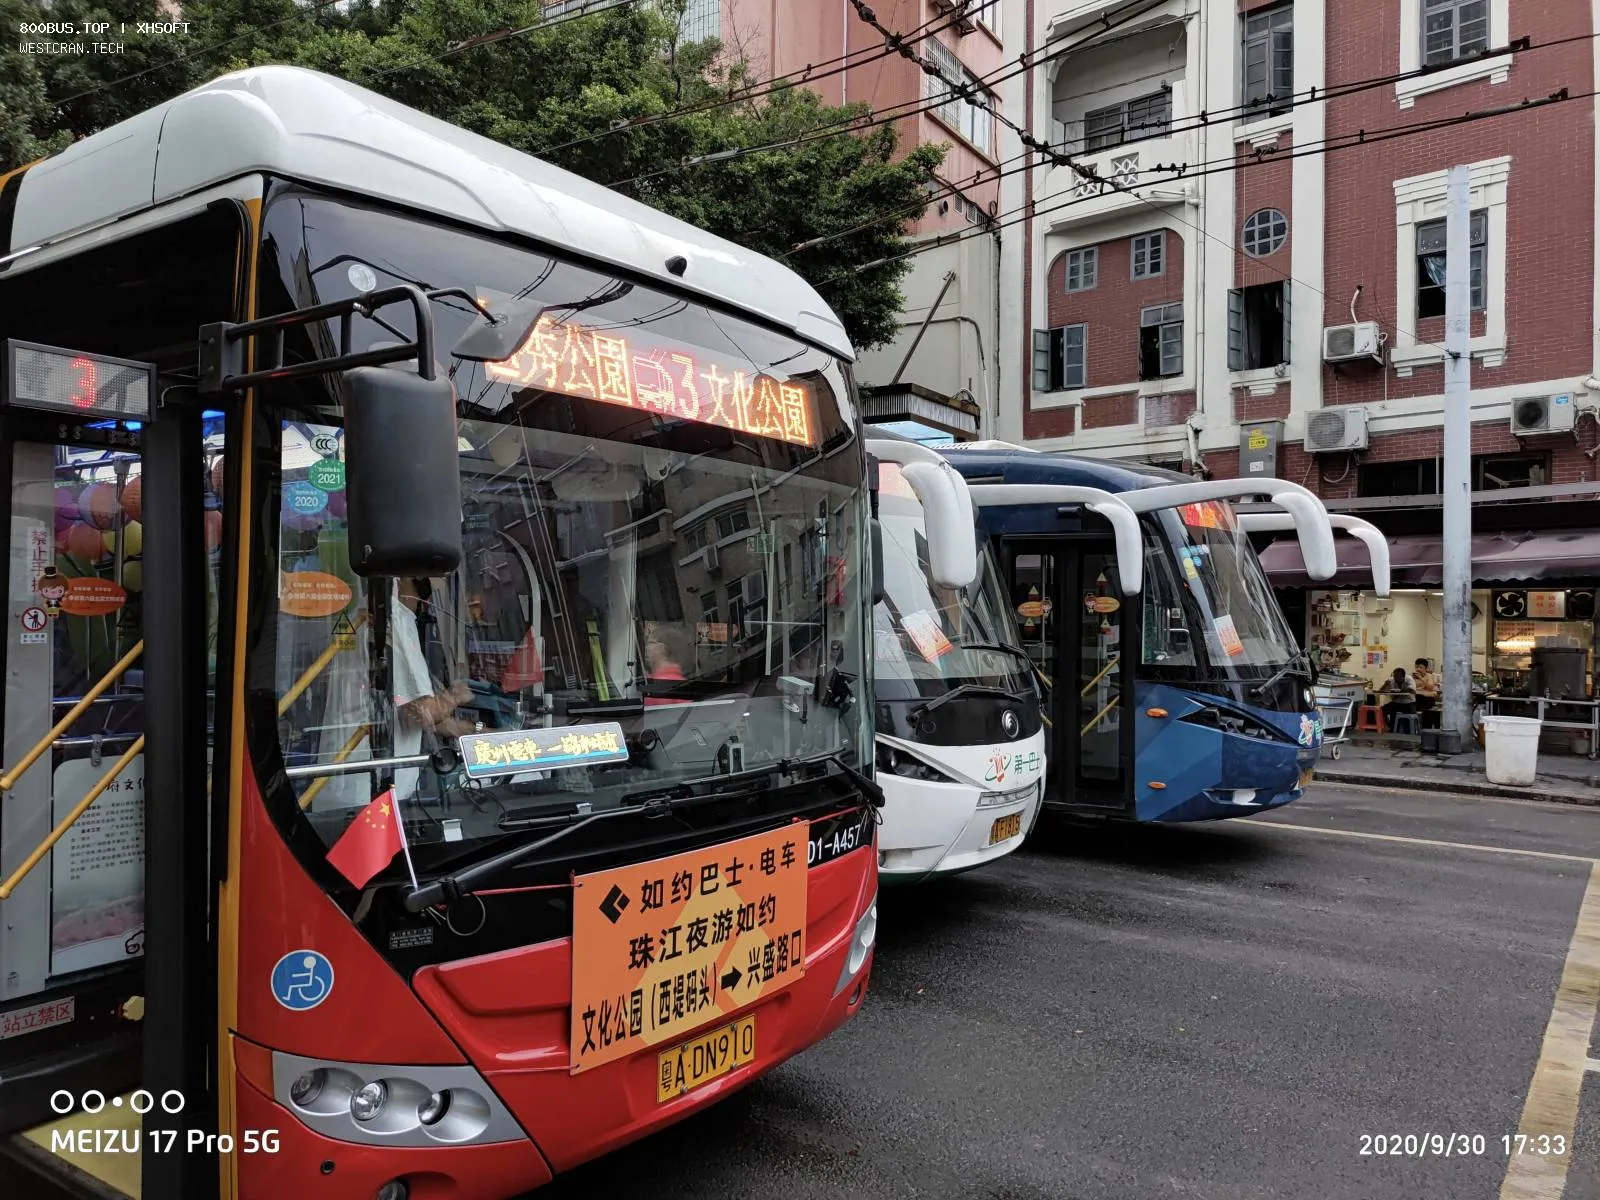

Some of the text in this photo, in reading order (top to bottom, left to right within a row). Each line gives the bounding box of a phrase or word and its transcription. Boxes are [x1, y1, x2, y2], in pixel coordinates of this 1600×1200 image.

[70, 357, 96, 408] 3
[671, 352, 701, 420] 3
[295, 496, 318, 507] 2020
[318, 473, 340, 484] 2021
[807, 824, 861, 864] D1-A457
[640, 841, 796, 913] 如约巴士·电车
[628, 893, 776, 970] 珠江夜游如约
[747, 929, 802, 988] 兴盛路口
[3, 1001, 71, 1033] 站立禁区
